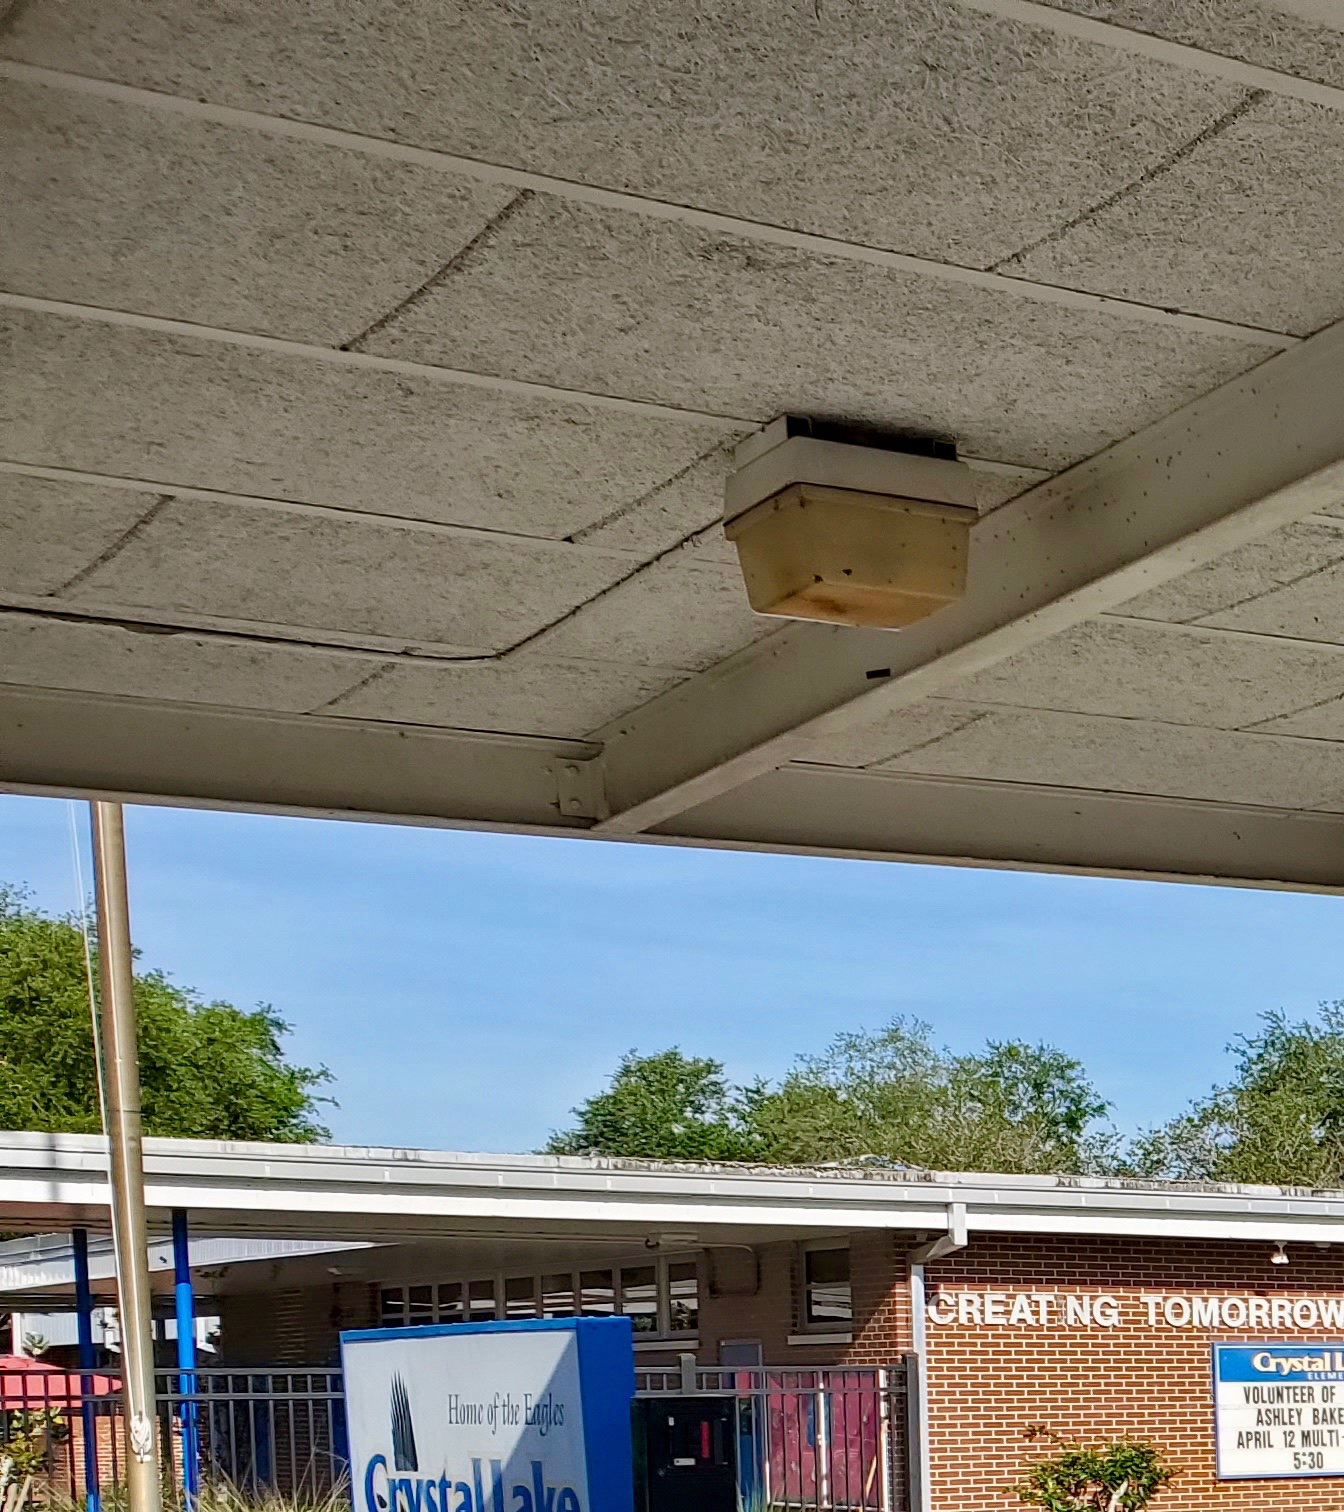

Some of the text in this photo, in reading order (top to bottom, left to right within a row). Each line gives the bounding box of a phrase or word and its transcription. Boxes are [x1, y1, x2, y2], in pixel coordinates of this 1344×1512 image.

[927, 1293, 1119, 1326] CREATNG
[1253, 1351, 1331, 1376] Crystal
[1243, 1385, 1315, 1404] VOLUNTEER
[1321, 1386, 1336, 1403] OF
[448, 1392, 564, 1436] Home of the Eagles
[1256, 1408, 1303, 1426] ASHLEY
[1237, 1430, 1274, 1449] APRIL
[1282, 1430, 1295, 1448] 12
[1293, 1451, 1324, 1470] 5:30
